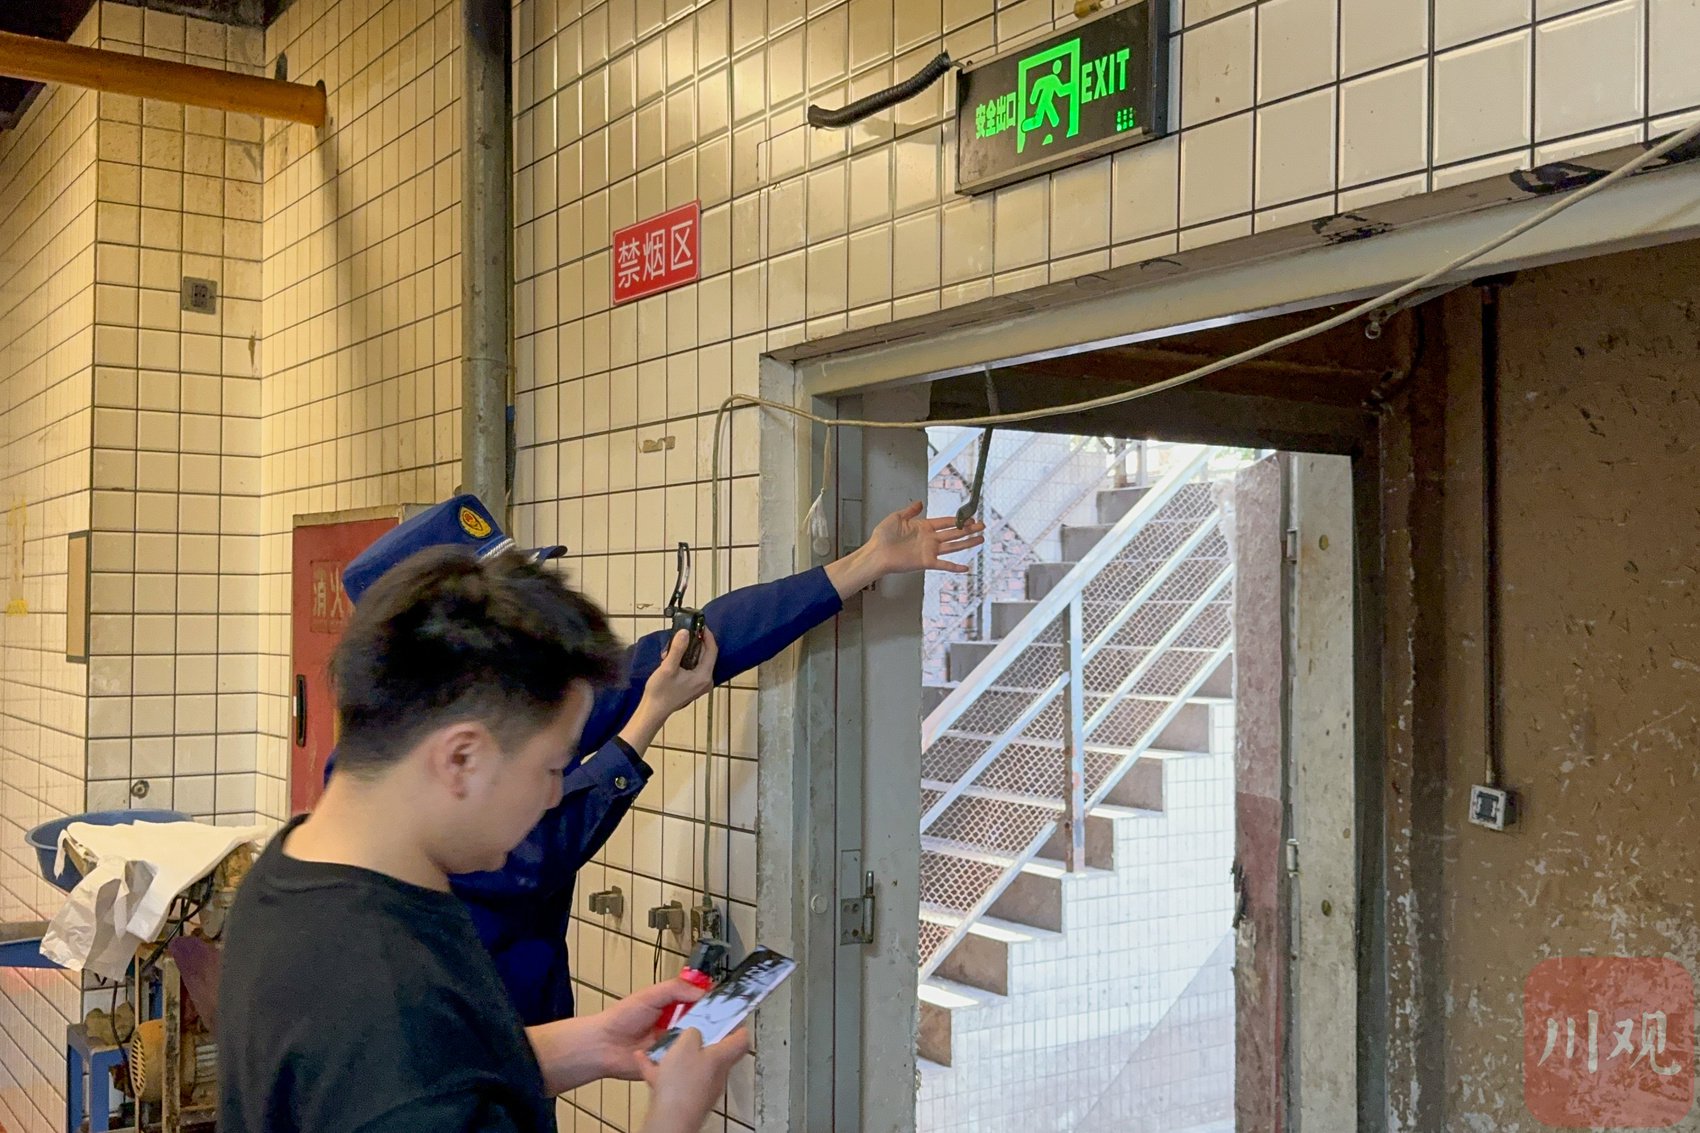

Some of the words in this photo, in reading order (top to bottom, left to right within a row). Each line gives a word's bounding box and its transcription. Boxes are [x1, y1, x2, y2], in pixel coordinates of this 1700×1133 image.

[1081, 48, 1130, 104] EXIT
[975, 91, 1017, 140] 安全出口
[618, 219, 694, 289] 禁烟区
